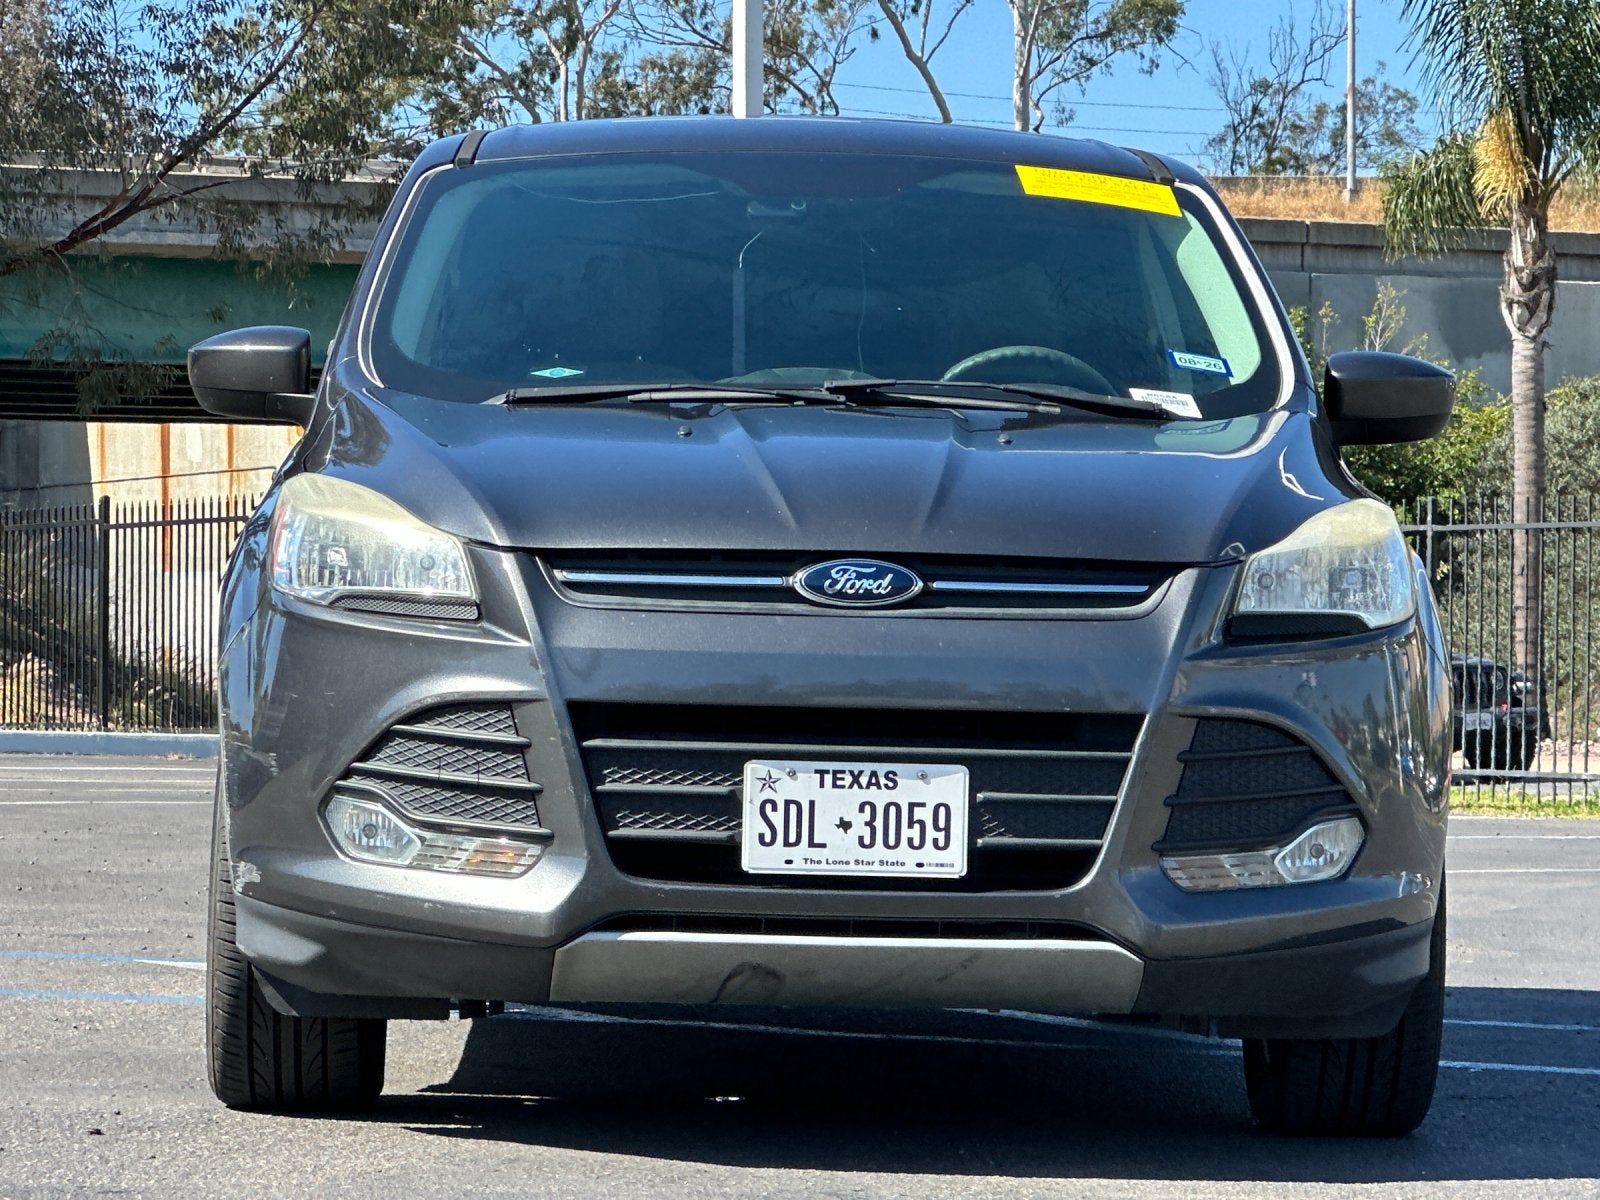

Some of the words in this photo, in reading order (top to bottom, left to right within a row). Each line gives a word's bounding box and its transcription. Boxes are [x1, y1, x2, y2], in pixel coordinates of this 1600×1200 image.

[823, 565, 894, 594] Ford
[814, 768, 899, 791] TEXAS
[758, 798, 827, 849] SDL
[857, 800, 952, 851] 3059
[802, 857, 823, 866] The
[825, 857, 851, 866] Lone
[853, 858, 876, 867] Star
[878, 859, 906, 868] State
